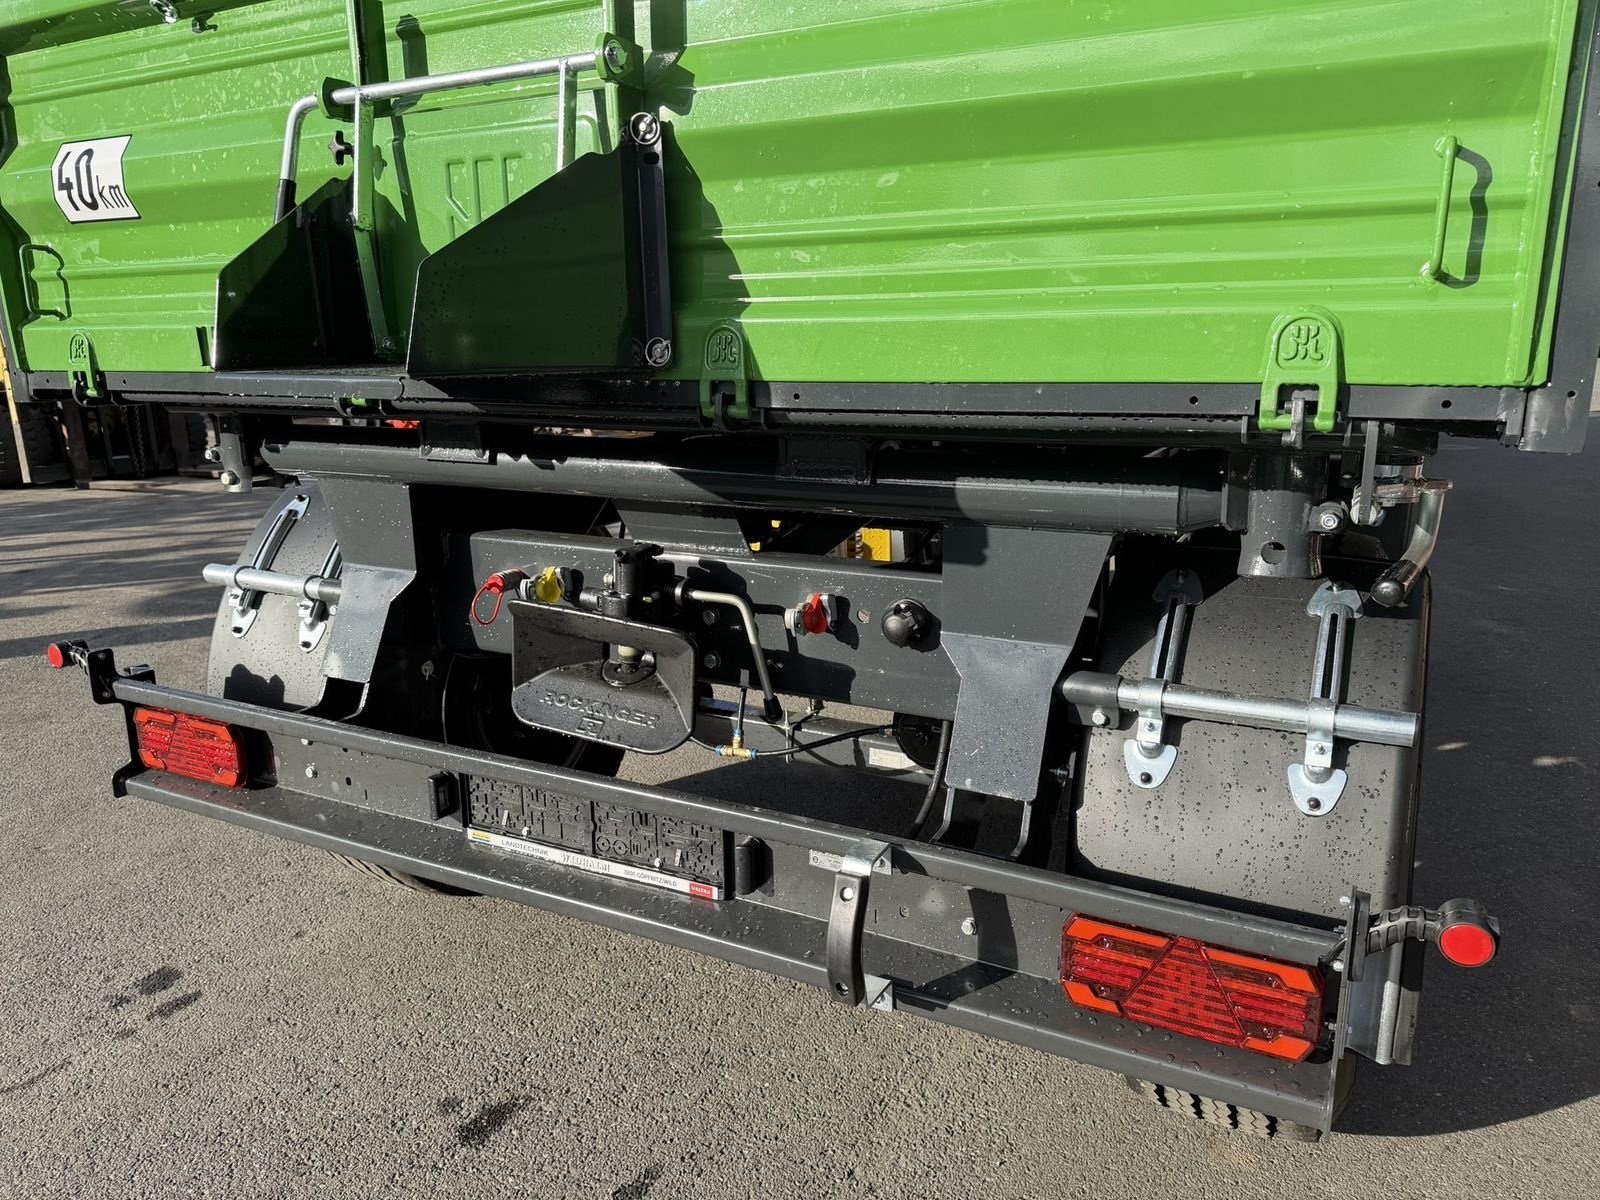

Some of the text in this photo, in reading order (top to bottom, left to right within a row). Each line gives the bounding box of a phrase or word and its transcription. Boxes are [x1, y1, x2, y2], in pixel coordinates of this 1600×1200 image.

[58, 148, 129, 211] 40 km
[501, 839, 549, 857] LANDTECHNIK
